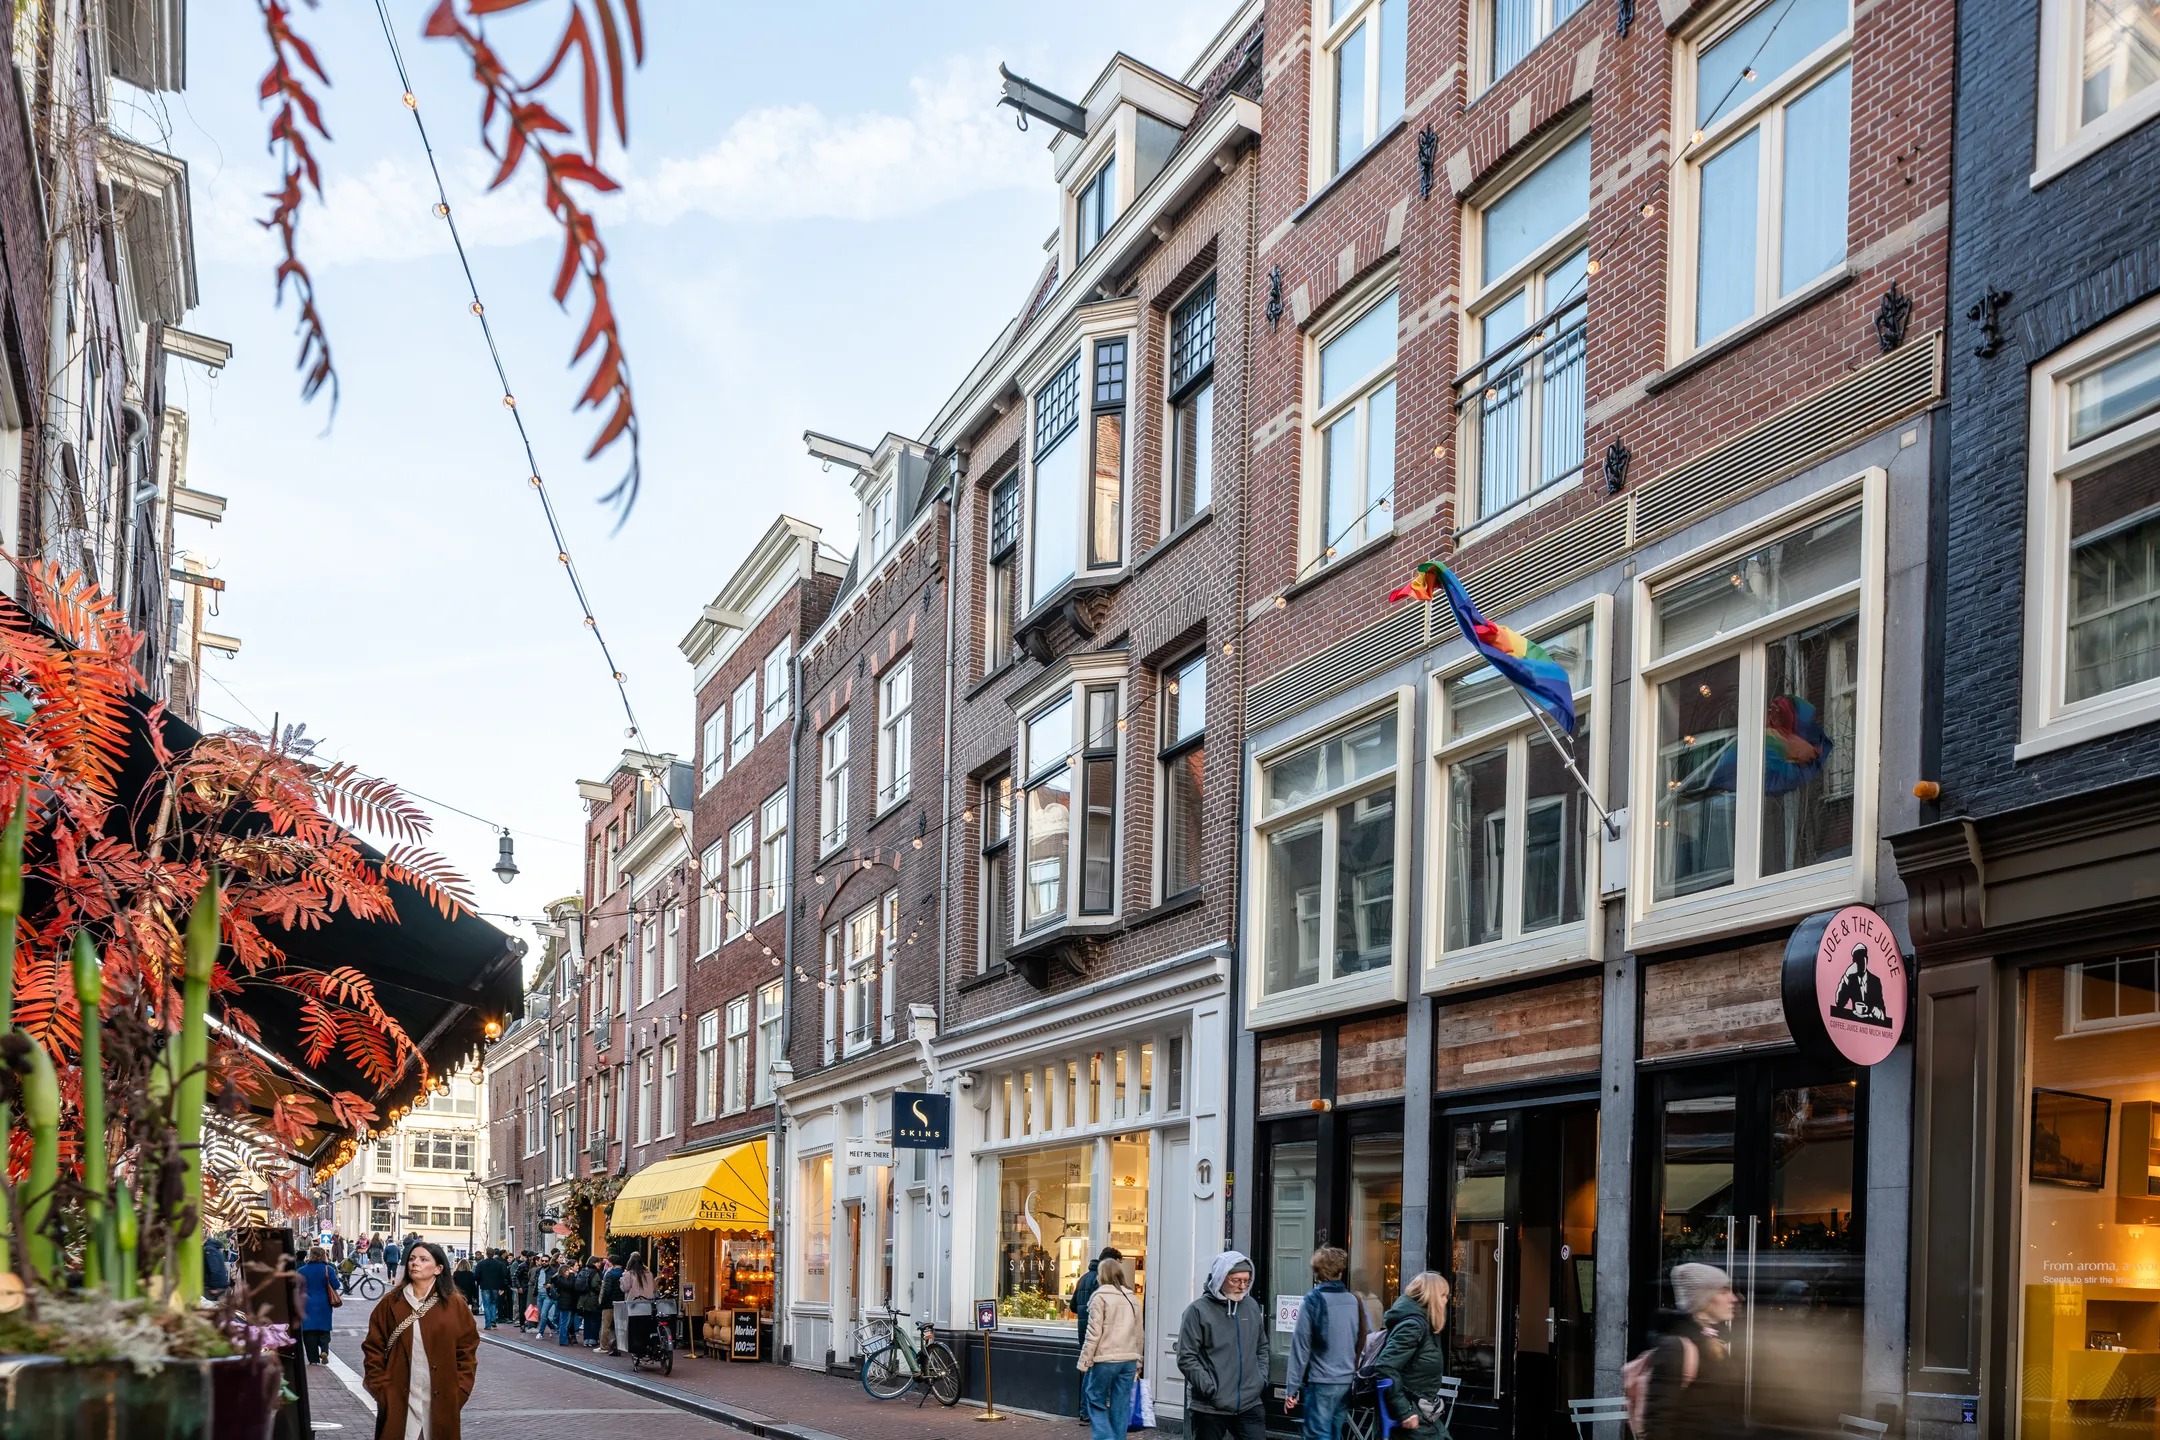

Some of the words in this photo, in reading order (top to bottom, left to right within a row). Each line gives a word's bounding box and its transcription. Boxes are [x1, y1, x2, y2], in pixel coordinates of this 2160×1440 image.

[1823, 928, 1842, 963] JOE
[1841, 919, 1851, 936] &
[1852, 916, 1874, 937] THE
[1875, 932, 1900, 978] JUICE
[1846, 1023, 1858, 1033] JUICE
[1859, 1026, 1868, 1035] AND
[1868, 1027, 1881, 1037] MUCH
[1881, 1031, 1893, 1039] MORE
[900, 1129, 940, 1138] SKINS
[849, 1150, 863, 1158] MEET
[1198, 1164, 1211, 1184] 11
[700, 1200, 737, 1212] KAAS
[698, 1211, 738, 1219] CHEESE
[1317, 1228, 1327, 1242] 13
[1009, 1259, 1056, 1272] SKINS
[2043, 1260, 2073, 1271] From
[2077, 1262, 2119, 1272] aroma,
[2123, 1263, 2130, 1271] a
[2043, 1276, 2071, 1284] Scents
[2073, 1276, 2081, 1284] to
[2084, 1275, 2097, 1284] stir
[2100, 1276, 2112, 1284] the
[735, 1325, 757, 1336] Morbier
[735, 1341, 746, 1352] 100
